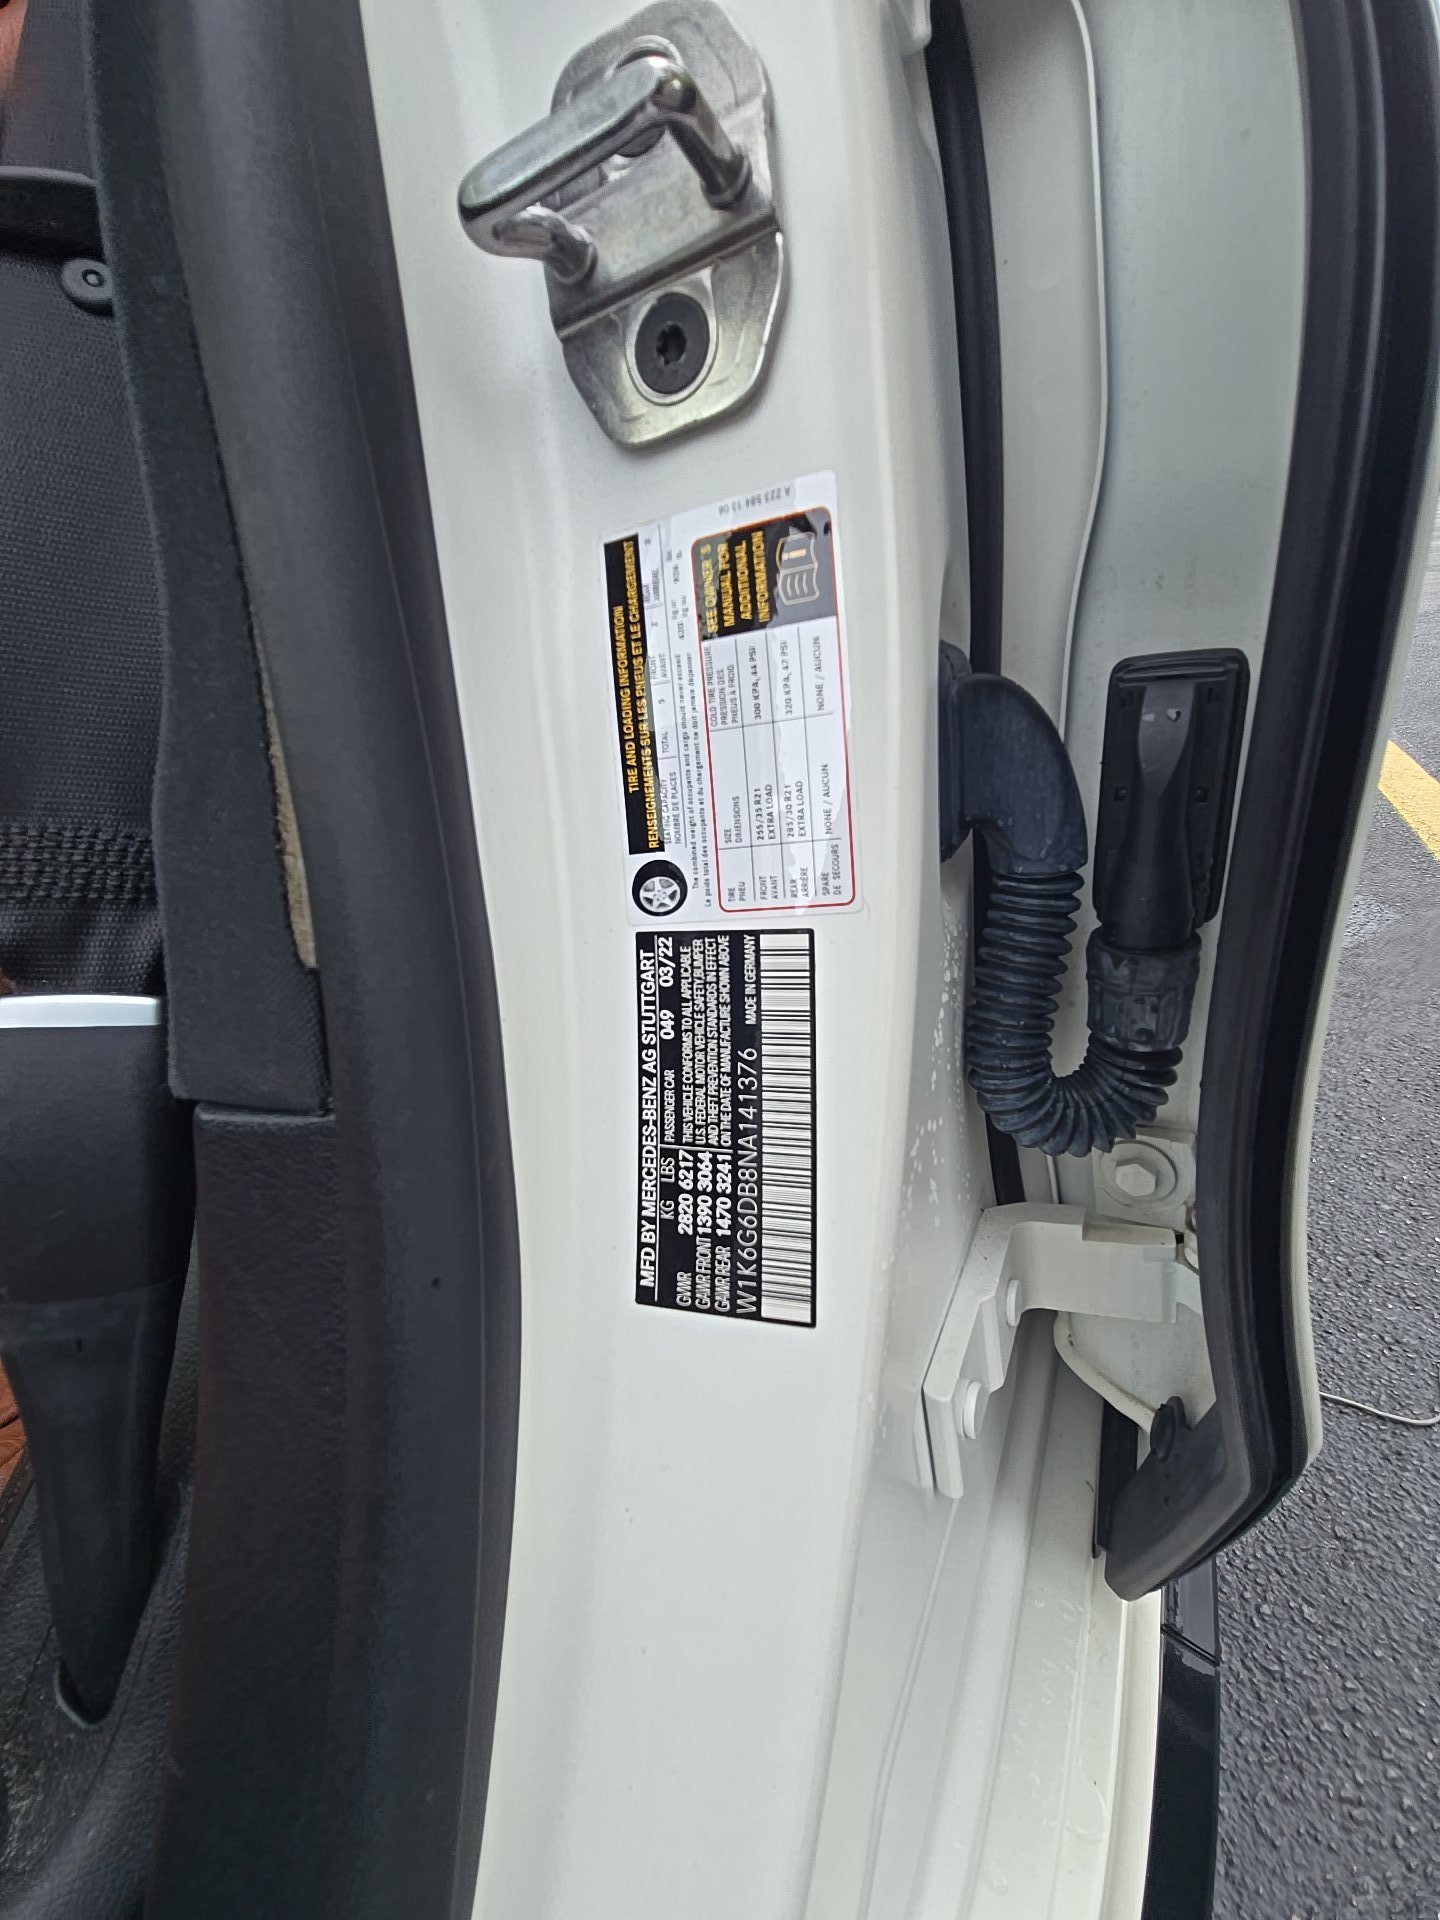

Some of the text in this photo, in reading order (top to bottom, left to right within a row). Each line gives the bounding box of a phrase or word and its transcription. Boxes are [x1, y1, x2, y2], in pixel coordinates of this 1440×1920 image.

[784, 485, 791, 496] A
[716, 541, 735, 627] MANUAL FOR
[734, 539, 752, 621] ADDITIONAL
[751, 529, 770, 623] INFORMATION
[705, 607, 718, 633] SEE
[658, 653, 667, 678] AVANT
[748, 645, 756, 662] PSI
[779, 640, 788, 657] PSI
[703, 646, 718, 727] COLD TIRE PRESSURE
[726, 664, 735, 688] FROID
[811, 636, 824, 711] NONE / AUCUN
[612, 604, 639, 793] TIRE AND LOADING INFORMATION
[622, 540, 659, 848] RENSEIGNEMENTS SUR LES PNEUS ET LE CHARGEMENT
[689, 688, 698, 713] jamais
[716, 668, 727, 725] PRESSION DES
[729, 697, 738, 724] PNEUS
[753, 702, 761, 720] 300
[784, 697, 793, 715] 320
[678, 705, 687, 729] should
[660, 731, 669, 753] TOTAL
[682, 731, 690, 751] cargo
[693, 731, 699, 740] ne
[682, 753, 690, 766] and
[693, 741, 704, 785] chargement
[684, 768, 694, 804] occupants
[696, 786, 703, 796] du
[820, 763, 830, 798] AUCUN
[659, 779, 671, 844] SEATING CAPACITY
[668, 771, 681, 843] NOMBRE DE PLACES
[697, 797, 704, 805] et
[753, 787, 764, 840] 255/35 R21
[764, 783, 775, 839] EXTRA LOAD
[783, 784, 795, 837] 285/30 R21
[795, 780, 806, 837] EXTRA LOAD
[687, 815, 697, 839] weight
[698, 807, 708, 843] occupants
[731, 795, 742, 843] DIMENSIONS
[823, 808, 833, 834] NONE
[688, 841, 698, 875] combined
[700, 845, 708, 857] des
[701, 859, 709, 875] total
[691, 877, 699, 888] The
[821, 872, 830, 895] SPARE
[830, 843, 841, 895] DE SECOURS
[703, 878, 712, 896] poids
[704, 898, 711, 907] Le
[727, 887, 735, 902] TIRE
[737, 881, 746, 901] PNEU
[758, 875, 767, 900] FRONT
[769, 874, 778, 899] AVANT
[789, 879, 798, 898] REAR
[658, 936, 675, 986] 03/22
[743, 934, 756, 1024] MADE IN GERMANY
[660, 1009, 674, 1039] 049
[694, 1012, 705, 1049] VEHICLE
[705, 937, 718, 1145] AND THEFT PREVENTION STANDARDS IN EFFECT
[717, 934, 731, 1146] ON THE DATE OF MANUFACTURE SHOWN ABOVE
[680, 945, 693, 1143] THIS VEHICLE CONFORMS TO ALL APPLICABLE
[694, 1050, 705, 1084] MOTOR
[640, 949, 656, 1287] MFD BY MERCEDES-BENZ AG STUTTGART
[664, 1069, 674, 1142] PASSENGER CAR
[694, 1085, 705, 1125] FEDERAL
[694, 1125, 705, 1145] U.S.
[660, 1156, 675, 1219] KG LBS
[736, 1047, 757, 1315] W1K6G6DB8NA141376
[676, 1149, 693, 1307] GVWR 2820 6217
[695, 1150, 712, 1310] GAWR FRONT 1390 3064
[714, 1153, 731, 1312] GAWR REAR 1470 3241
